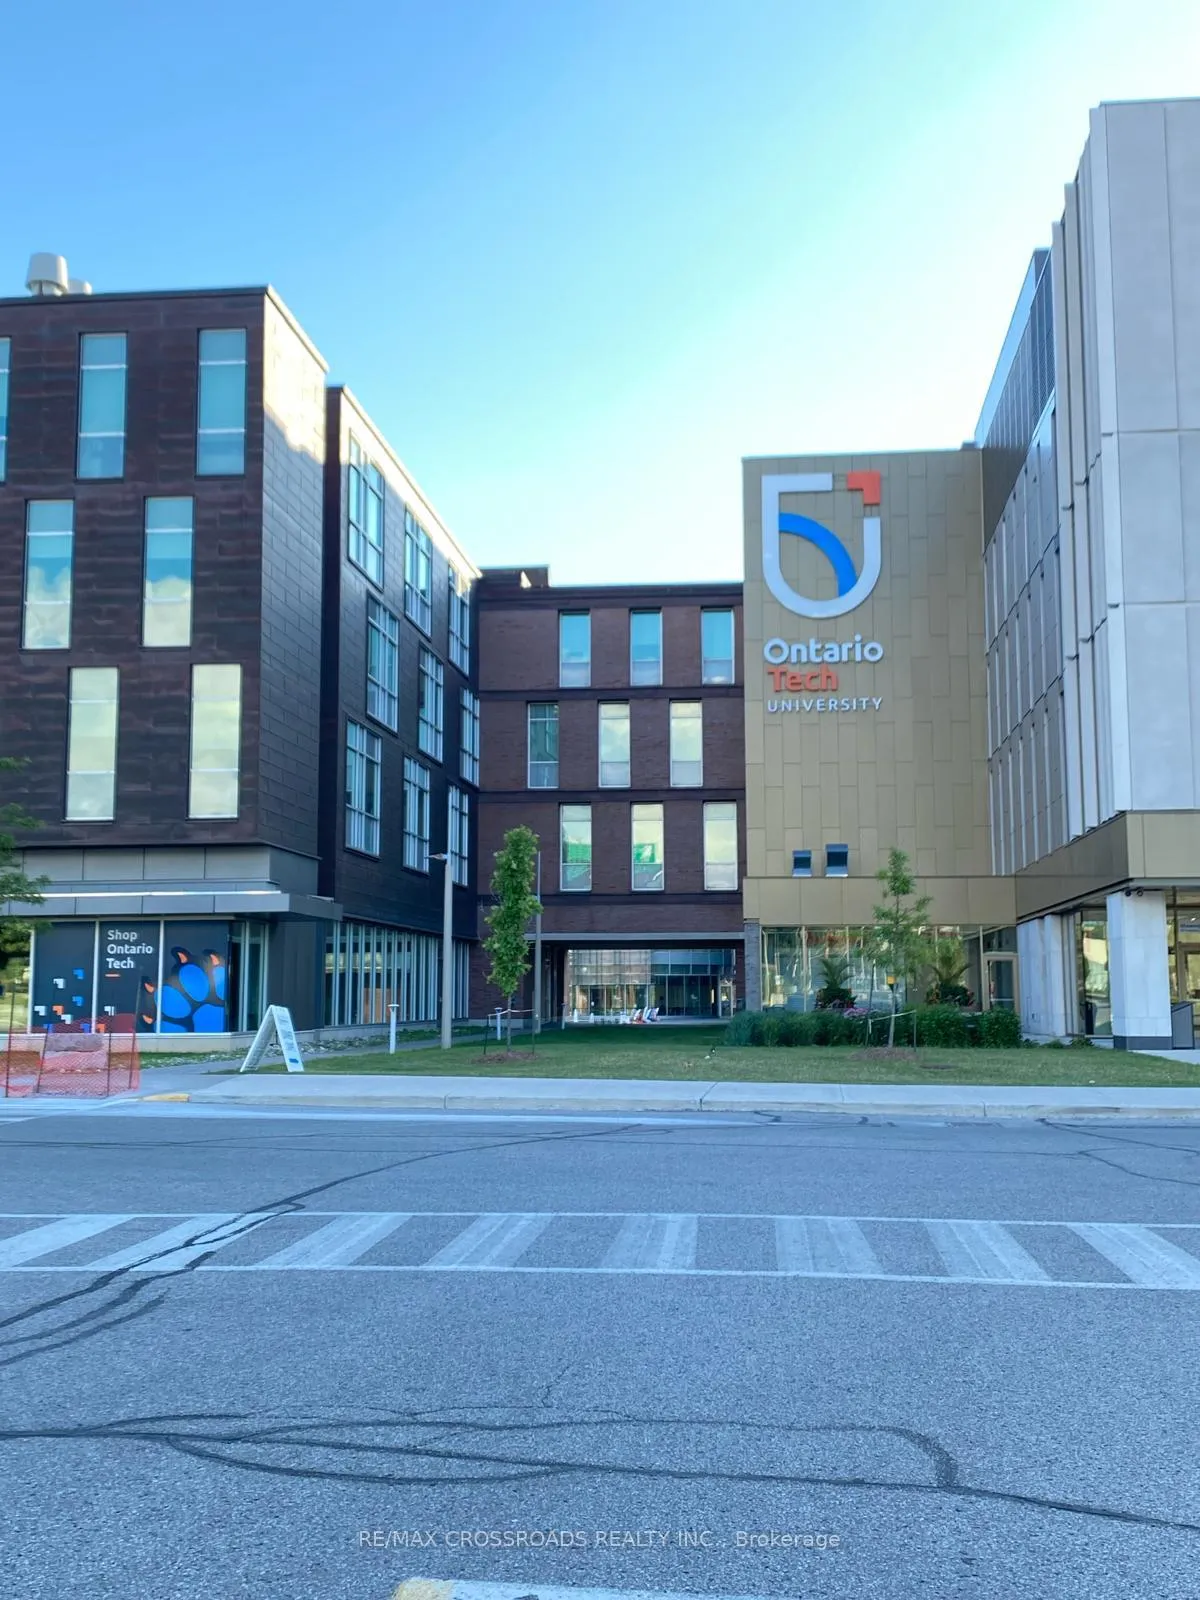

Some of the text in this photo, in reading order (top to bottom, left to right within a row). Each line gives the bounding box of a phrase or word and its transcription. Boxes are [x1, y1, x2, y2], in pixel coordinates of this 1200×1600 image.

[764, 633, 884, 664] Ontario
[767, 664, 839, 692] Tech
[767, 697, 883, 713] UNIVERSITY
[107, 929, 138, 942] Shop
[107, 943, 153, 955] Ontario
[106, 957, 135, 969] Tech
